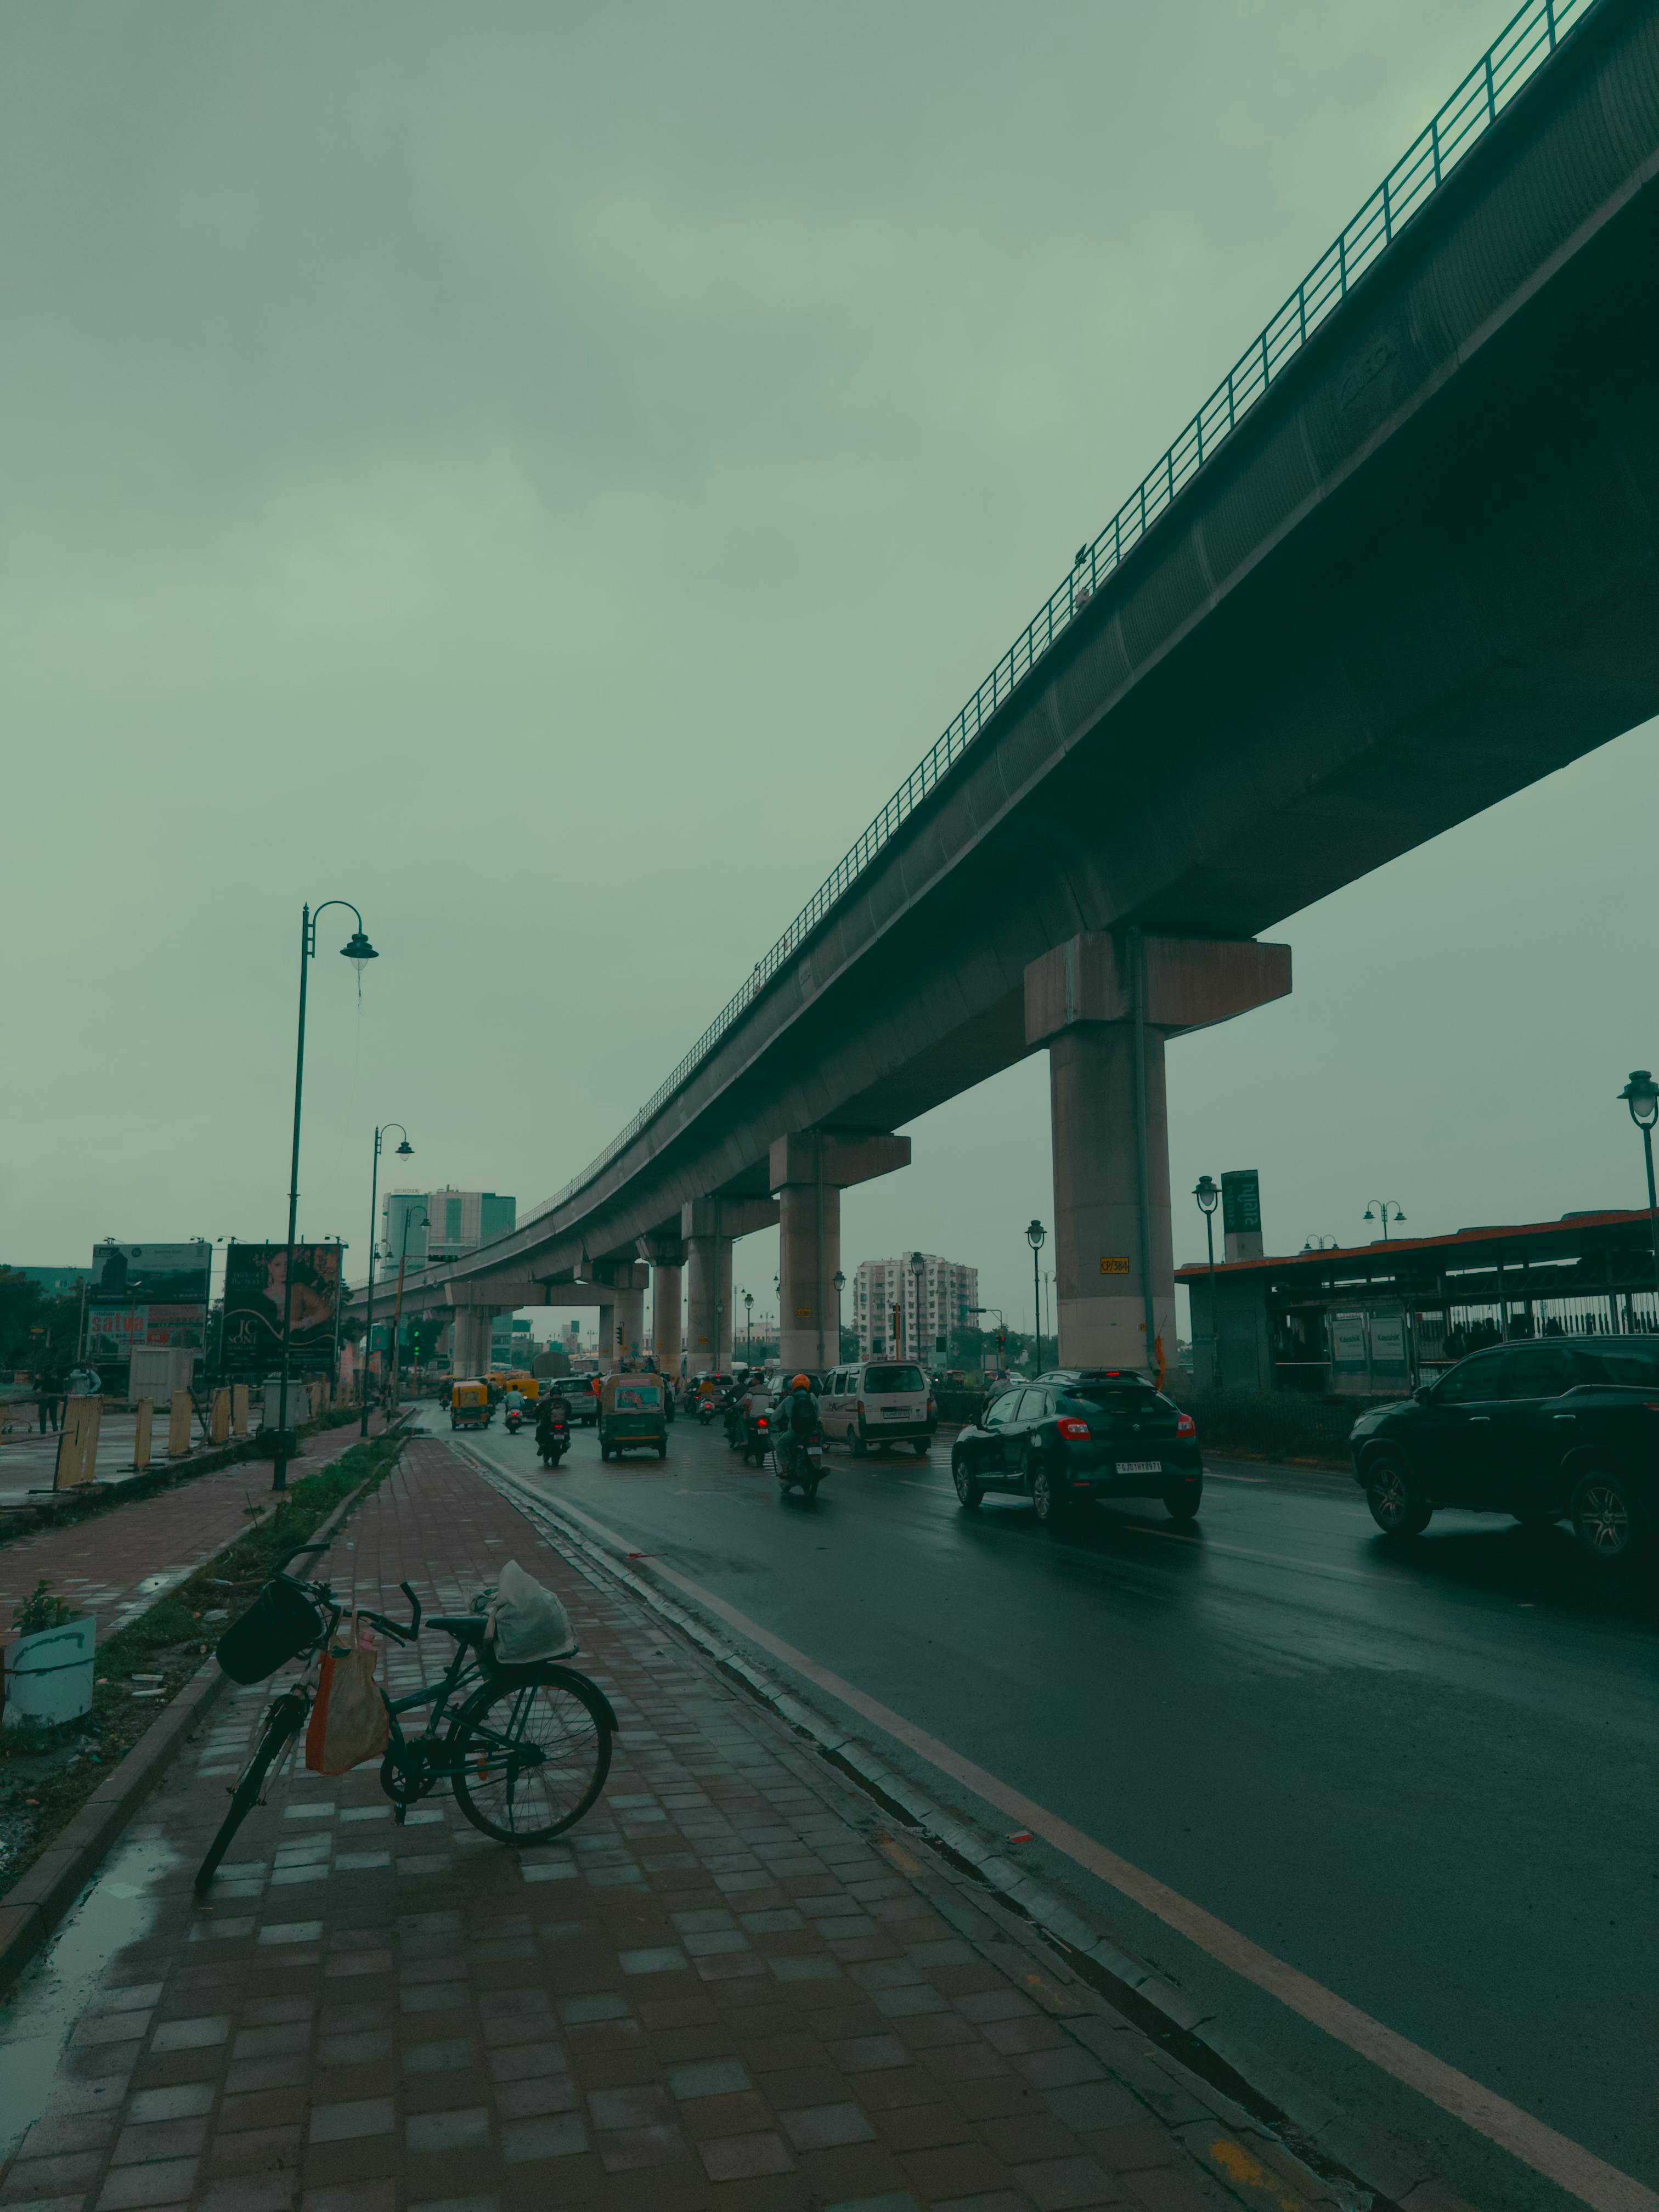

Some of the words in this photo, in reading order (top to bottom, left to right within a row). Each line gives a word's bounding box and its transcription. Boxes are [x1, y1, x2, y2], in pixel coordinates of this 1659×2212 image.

[1102, 1260, 1128, 1272] CP/384
[239, 1319, 258, 1335] JC
[228, 1335, 256, 1344] SONI
